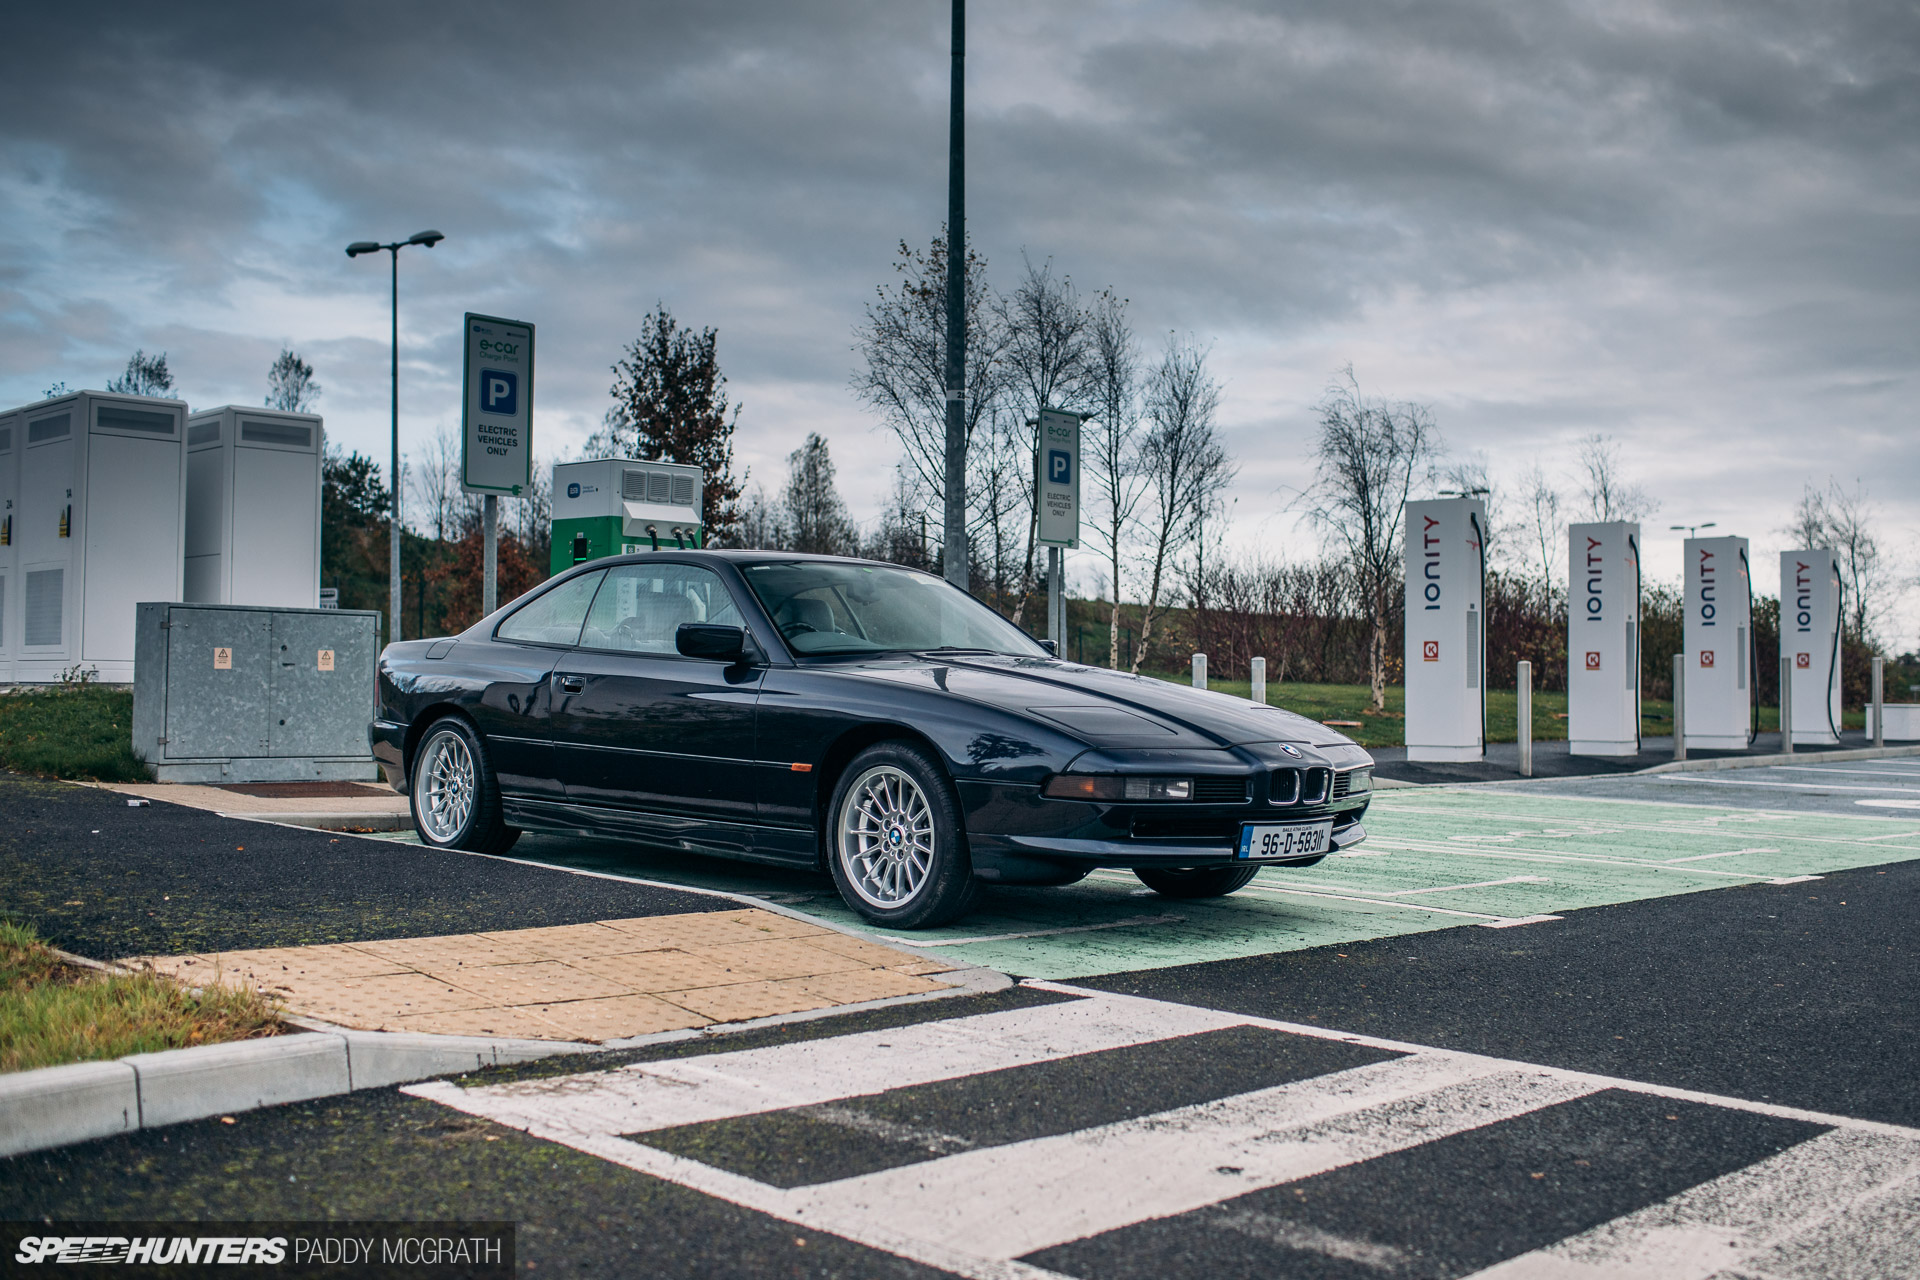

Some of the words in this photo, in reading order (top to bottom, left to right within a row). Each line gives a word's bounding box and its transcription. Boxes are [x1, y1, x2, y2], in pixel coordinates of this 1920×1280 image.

[480, 339, 519, 355] e-car
[489, 378, 510, 406] P
[478, 424, 518, 437] ELECTRIC
[1048, 426, 1071, 438] e-car
[477, 434, 518, 447] VEHICLES
[486, 446, 509, 457] ONLY
[1053, 456, 1067, 479] P
[1047, 492, 1071, 502] ELECTRIC
[1047, 500, 1072, 510] VEHICLES
[1052, 508, 1066, 517] ONLY
[1424, 515, 1440, 610] IONITY
[1587, 536, 1602, 621] IONITY
[1700, 549, 1715, 626] IONITY
[1797, 561, 1811, 632] IONITY
